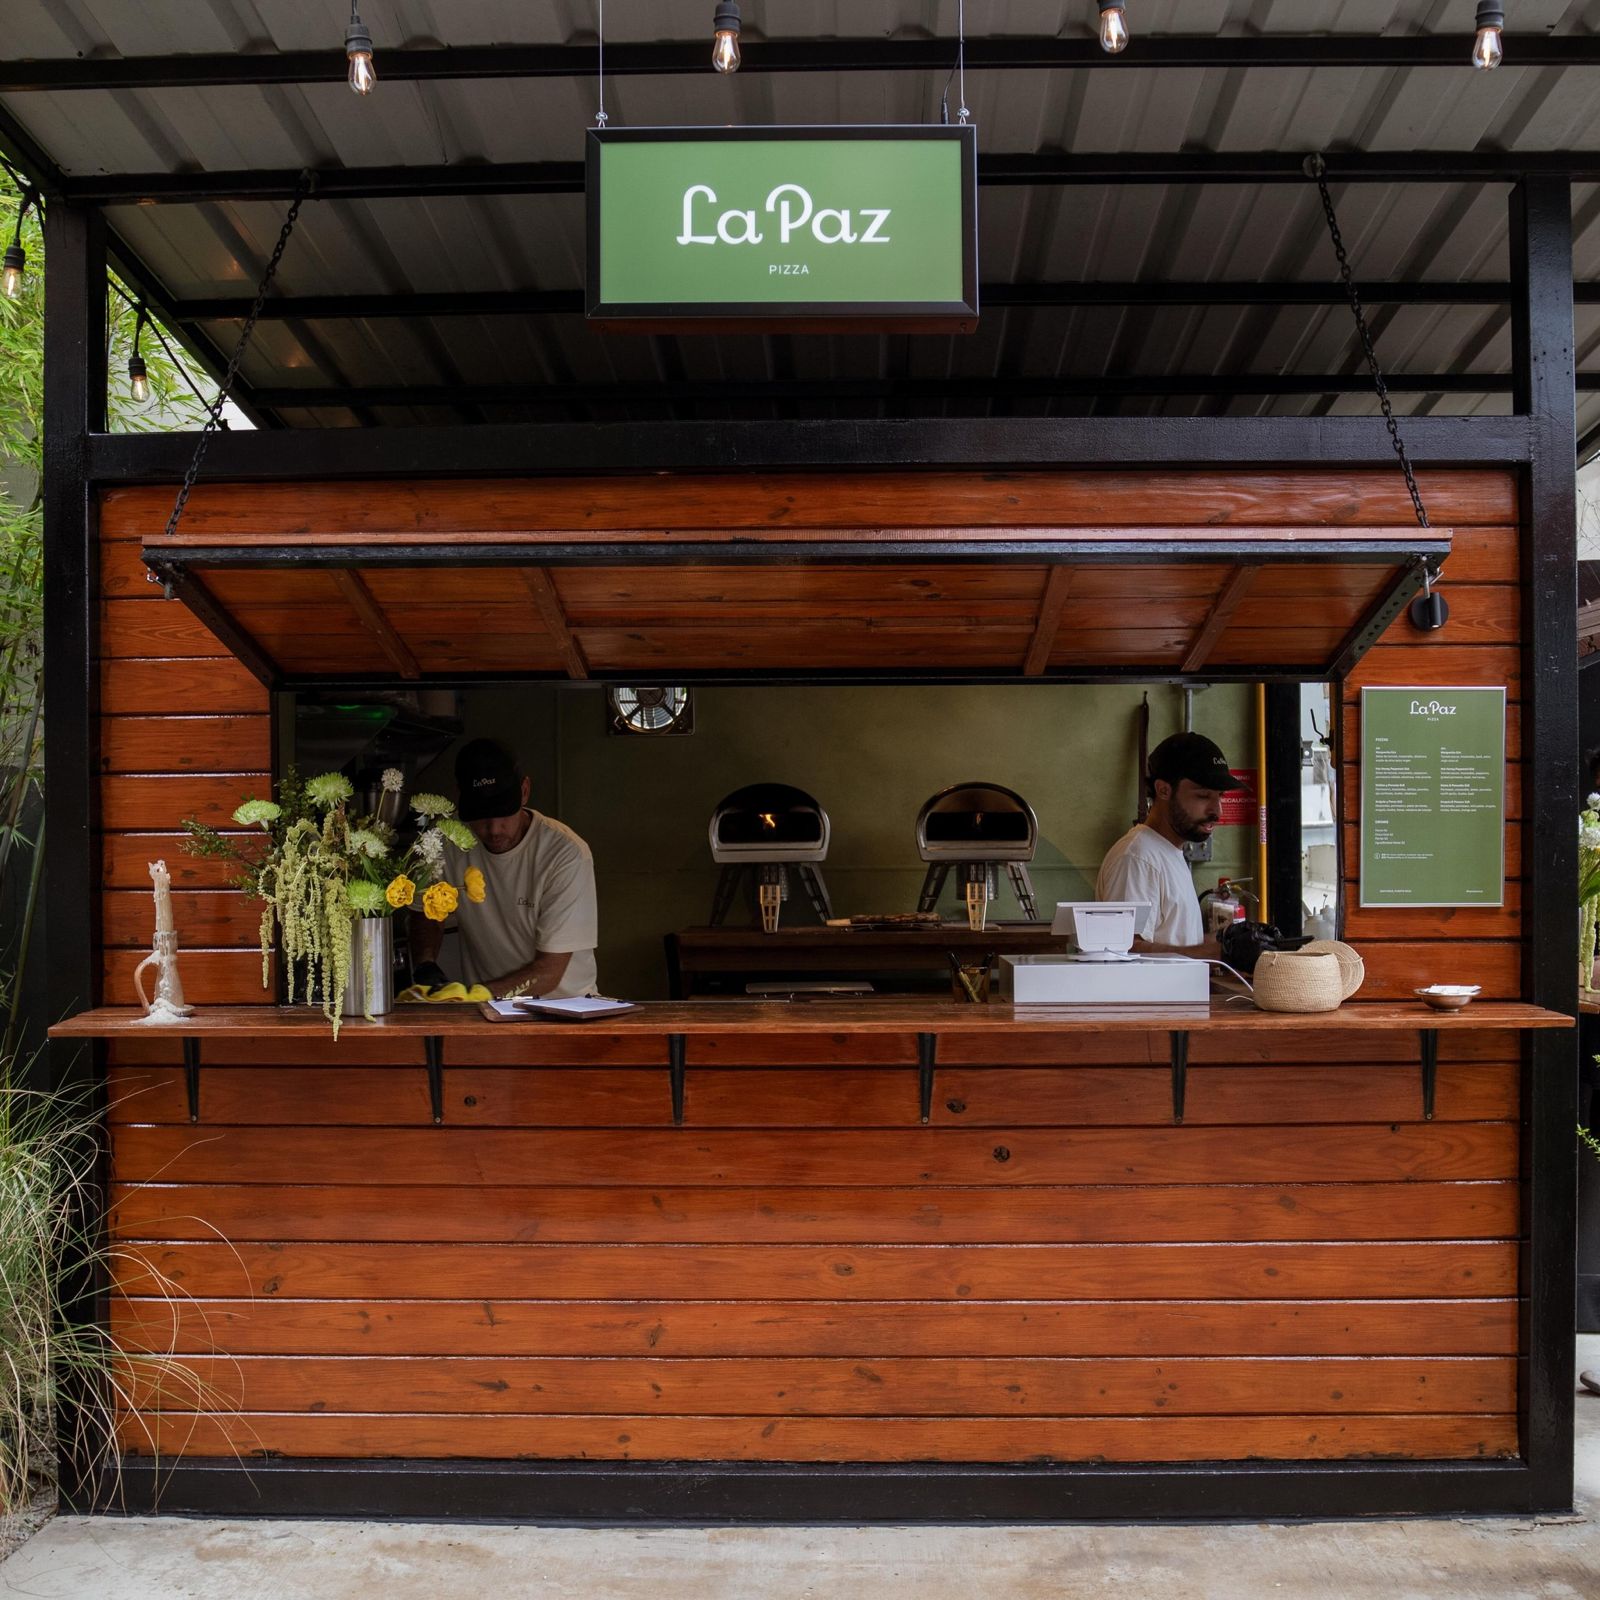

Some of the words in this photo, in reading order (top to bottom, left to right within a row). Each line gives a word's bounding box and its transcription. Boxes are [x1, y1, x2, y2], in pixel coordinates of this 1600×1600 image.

[676, 184, 763, 246] La
[765, 183, 892, 245] Paz
[768, 263, 810, 275] PIZZA
[1429, 701, 1457, 715] Paz
